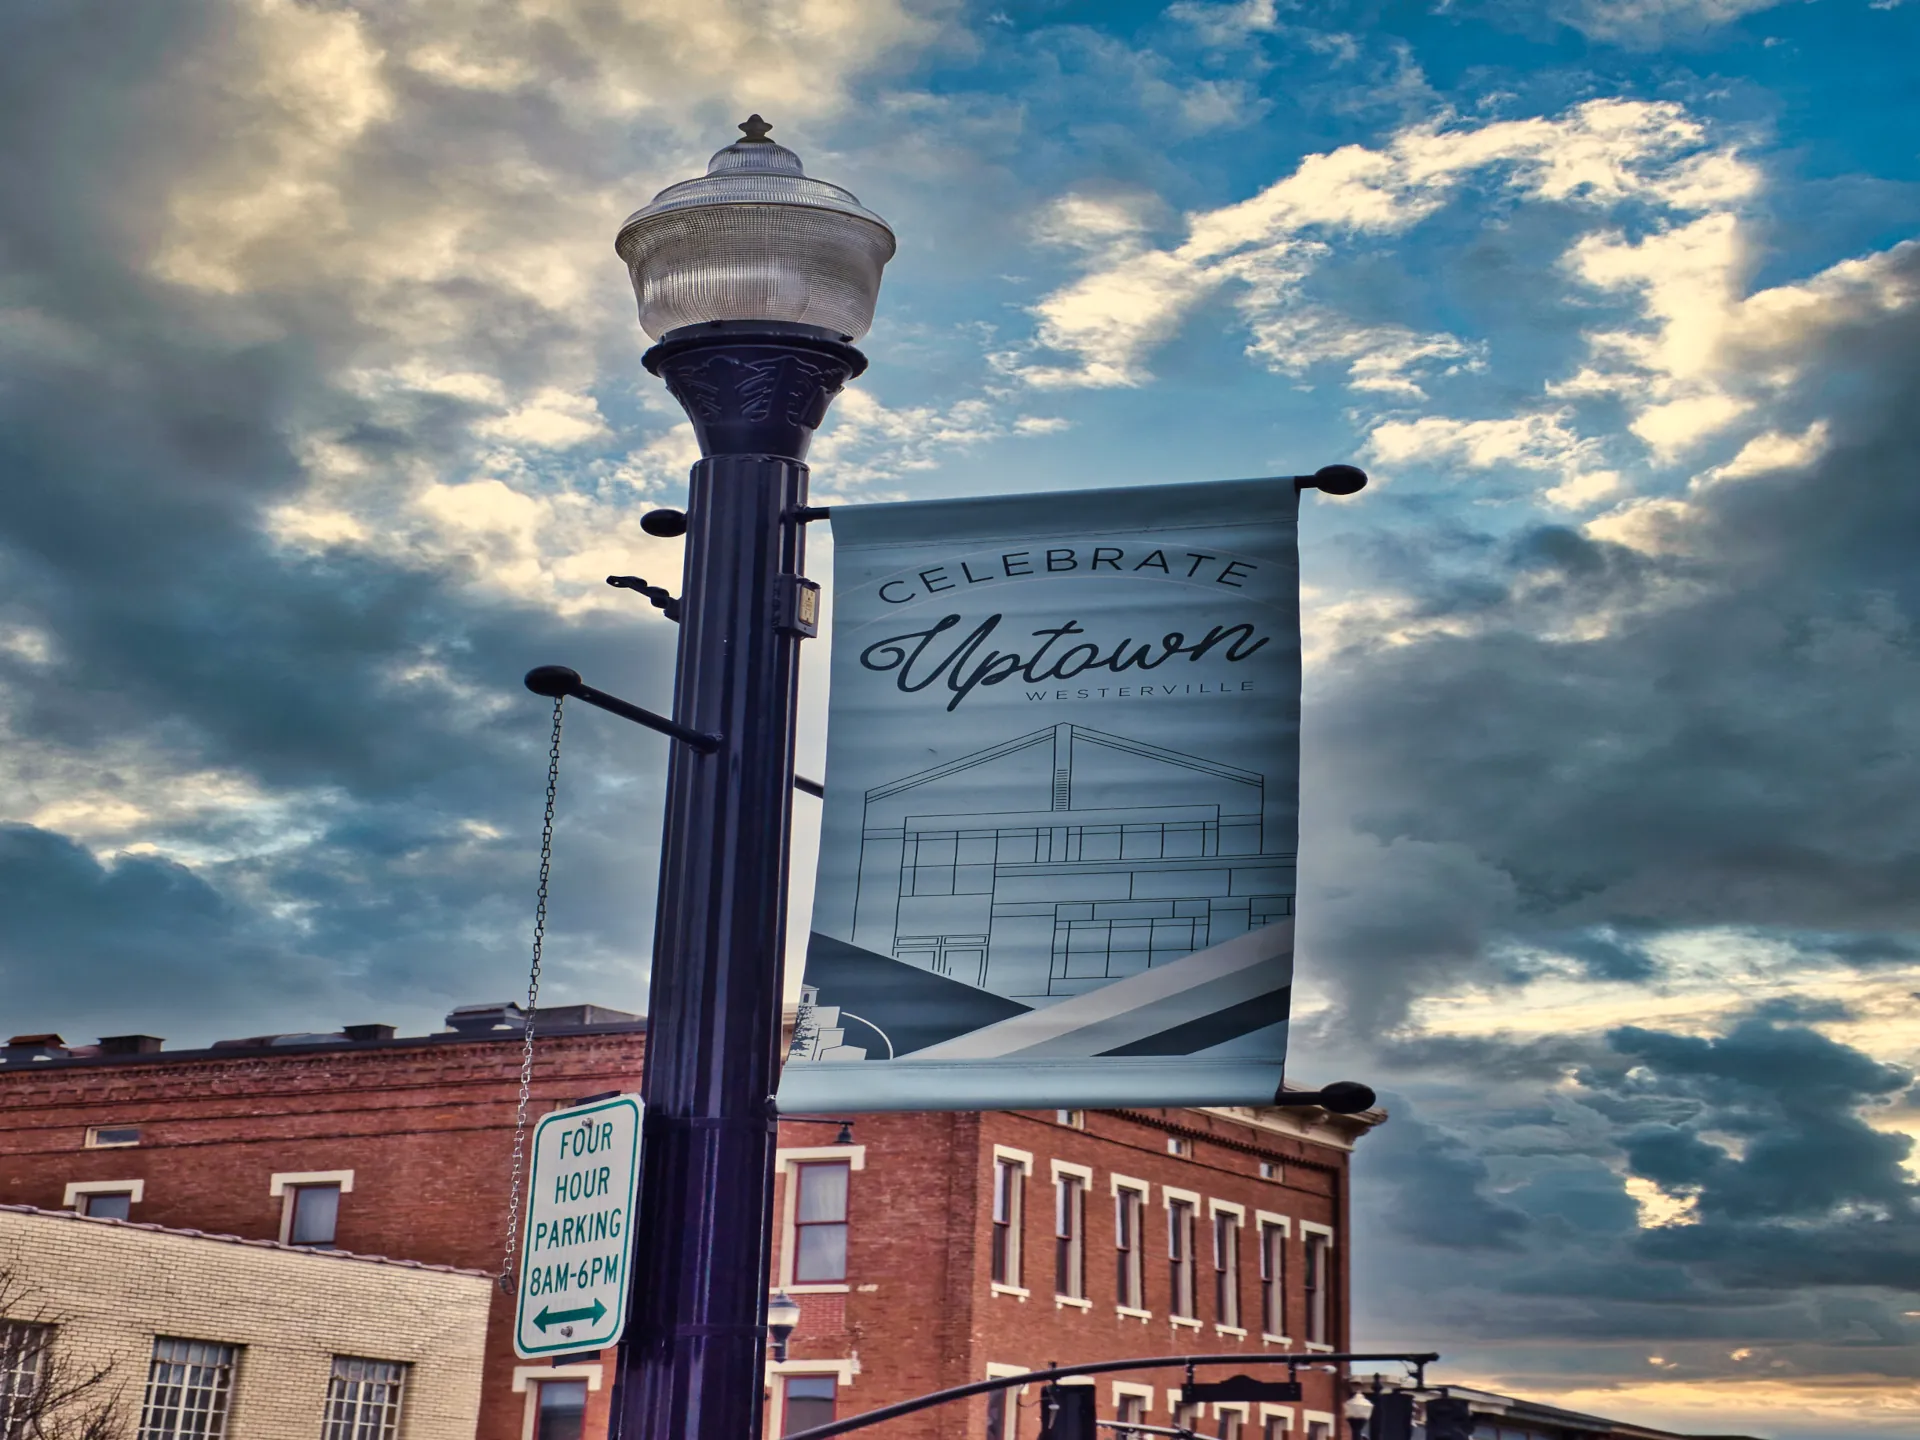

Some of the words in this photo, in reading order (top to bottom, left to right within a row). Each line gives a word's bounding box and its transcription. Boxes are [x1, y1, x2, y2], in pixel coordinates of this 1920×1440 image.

[878, 547, 1258, 604] CELEBRATE
[860, 613, 1271, 712] Uptown
[1026, 681, 1255, 702] WESTERVILLE
[560, 1122, 613, 1160] FOUR
[555, 1167, 611, 1204] HOUR
[534, 1208, 621, 1252] PARKING
[530, 1254, 619, 1297] 8AM-6PM
